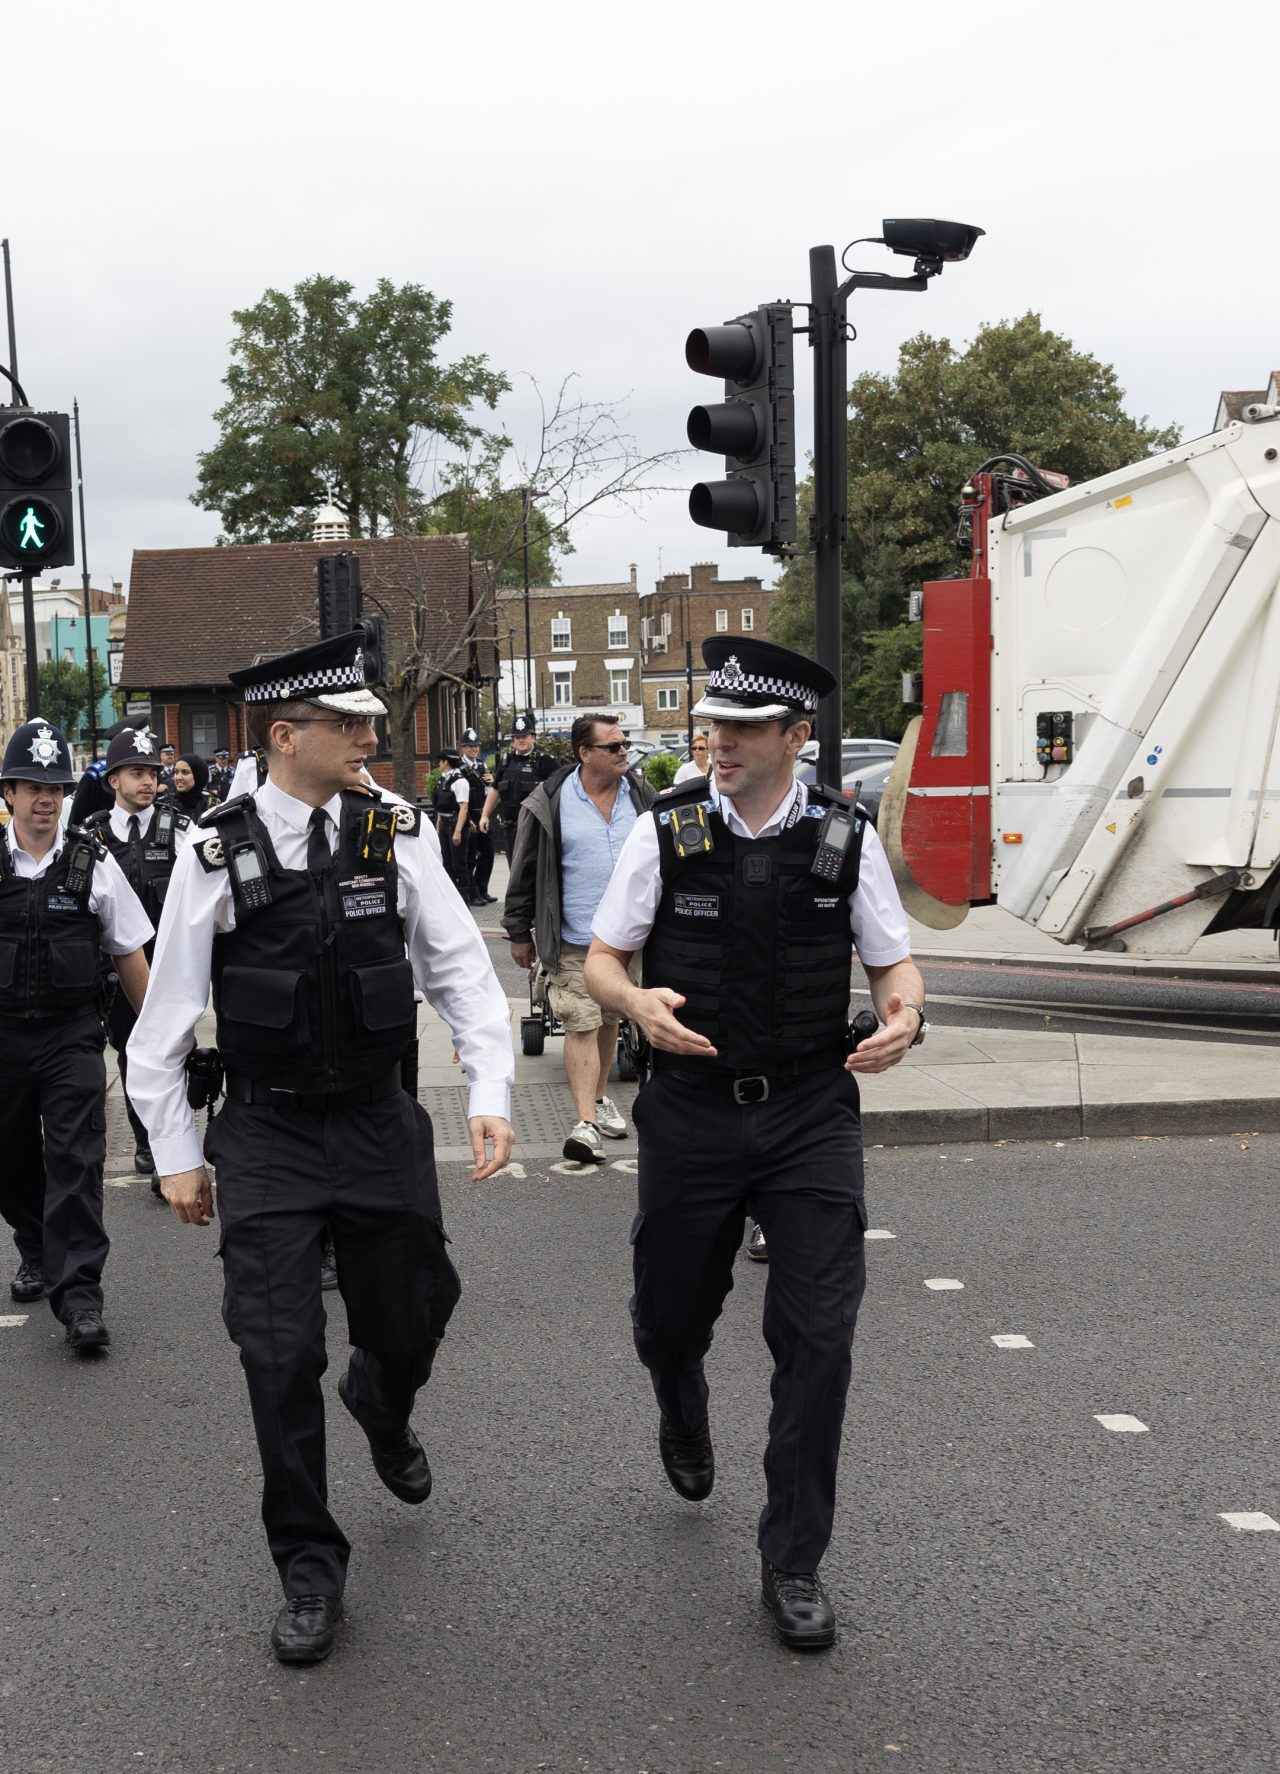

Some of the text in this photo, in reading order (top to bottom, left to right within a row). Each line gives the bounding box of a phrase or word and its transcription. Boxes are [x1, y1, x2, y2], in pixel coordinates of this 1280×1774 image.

[345, 906, 387, 917] POLICE OFFICER
[674, 907, 719, 917] POLICE OFFICER
